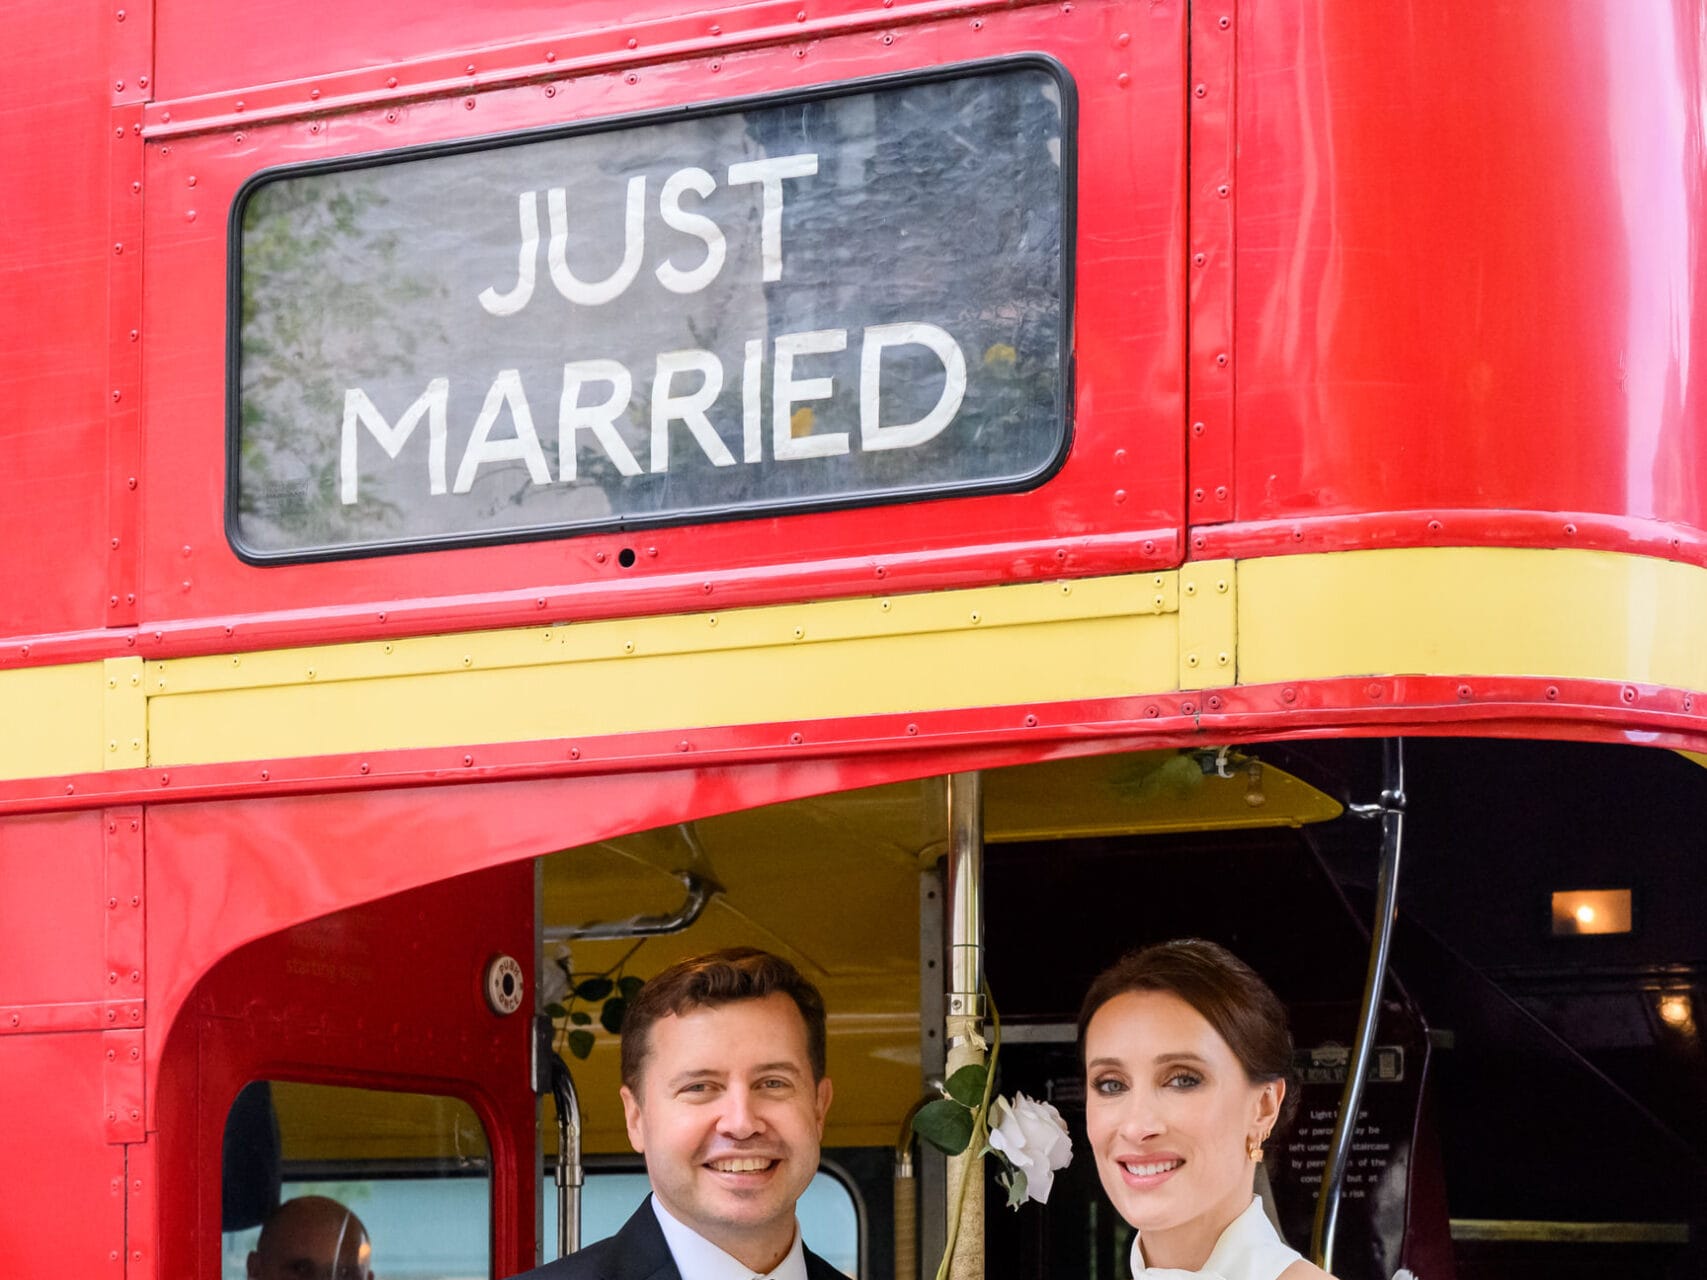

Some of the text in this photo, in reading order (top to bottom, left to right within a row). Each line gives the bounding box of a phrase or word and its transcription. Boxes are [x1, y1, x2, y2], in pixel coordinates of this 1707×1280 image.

[478, 153, 818, 317] JUST
[340, 321, 967, 505] MARRIED
[499, 960, 519, 976] PUSH
[499, 993, 519, 1010] ONCE
[1310, 1110, 1332, 1120] Light
[1298, 1128, 1308, 1136] or
[1368, 1126, 1380, 1135] be
[1288, 1143, 1390, 1152] left unde staircase
[1292, 1159, 1303, 1169] by
[1346, 1175, 1378, 1183] but at
[1349, 1190, 1365, 1198] risk
